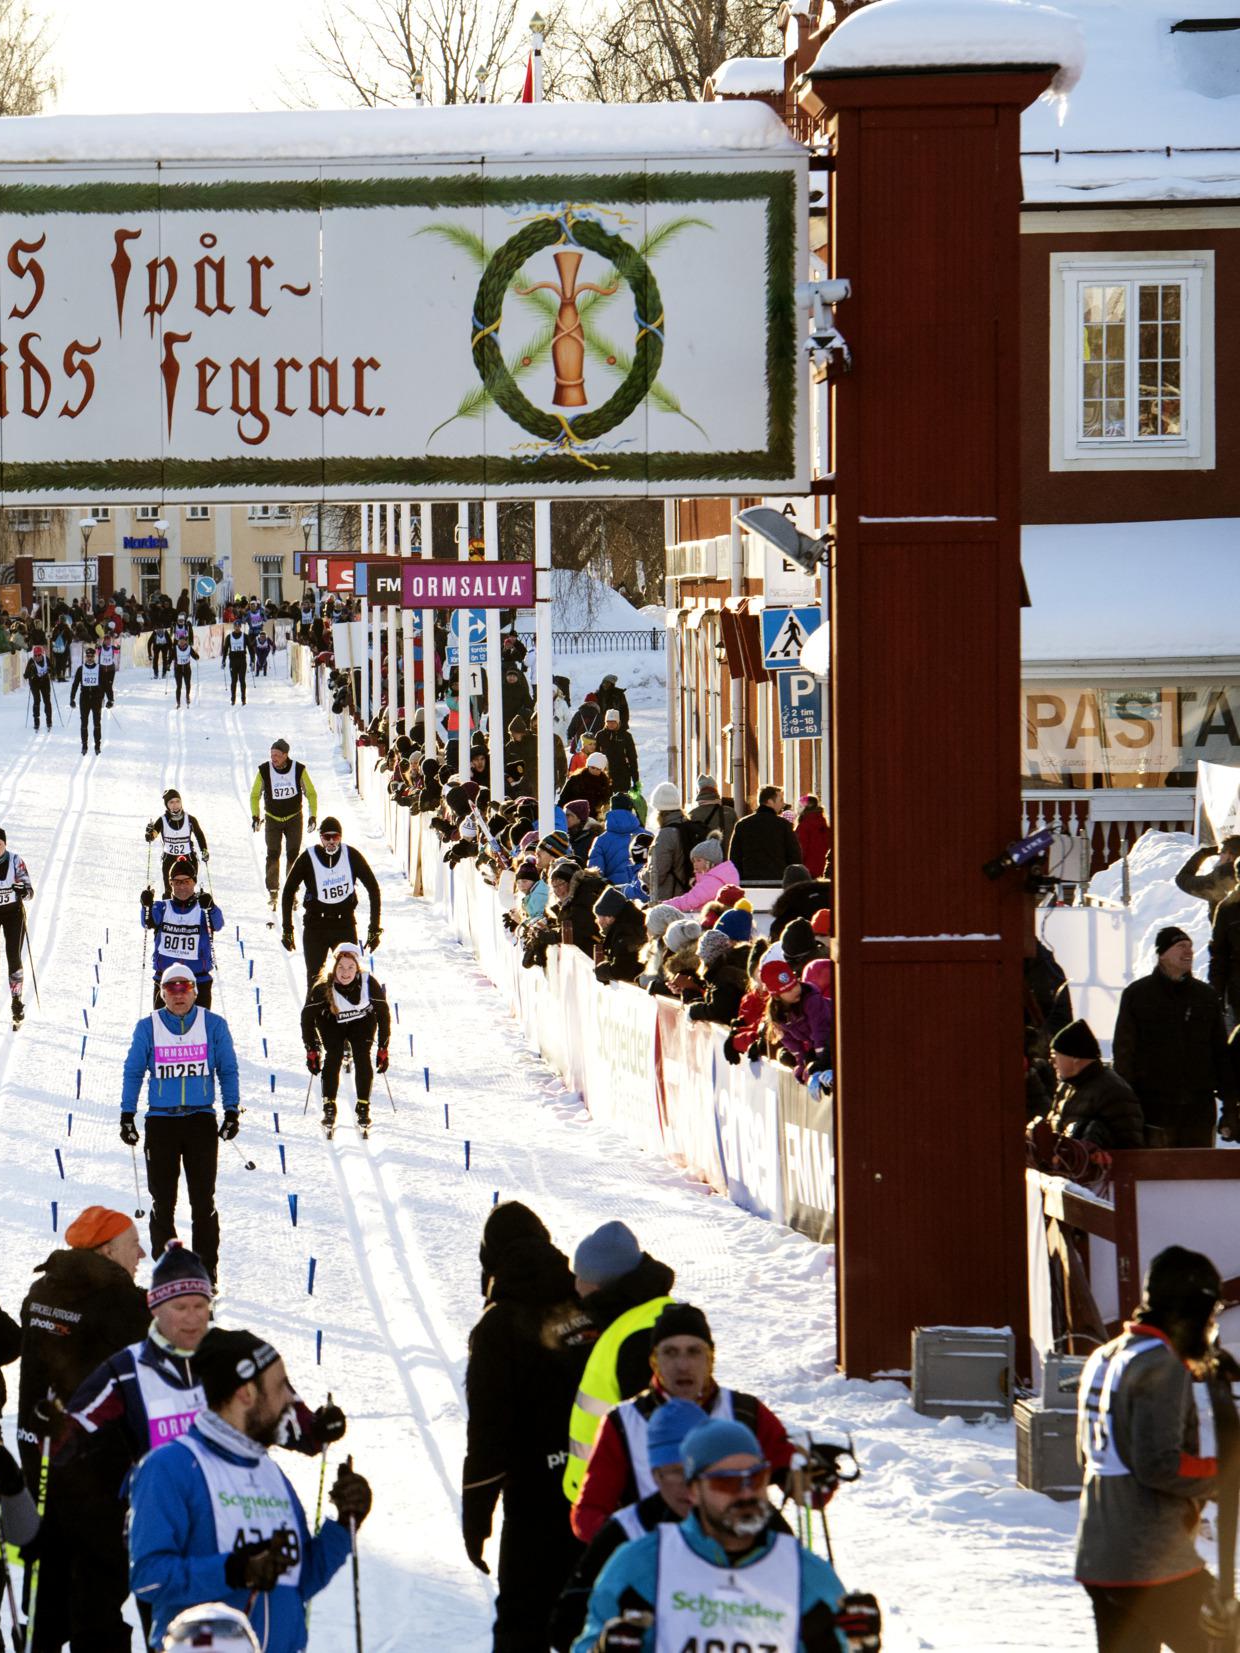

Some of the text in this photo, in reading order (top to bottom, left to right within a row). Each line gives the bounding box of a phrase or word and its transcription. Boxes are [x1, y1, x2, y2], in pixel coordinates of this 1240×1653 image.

[123, 535, 168, 549] Nordea
[790, 674, 815, 707] P
[1027, 691, 1240, 749] PASTA
[790, 725, 818, 735] (9-15)
[274, 787, 295, 798] 9721
[169, 844, 185, 855] 262
[322, 883, 350, 900] 1667
[164, 936, 195, 951] 8019
[158, 1046, 205, 1058] ORMSALVA
[158, 1062, 206, 1080] 10267
